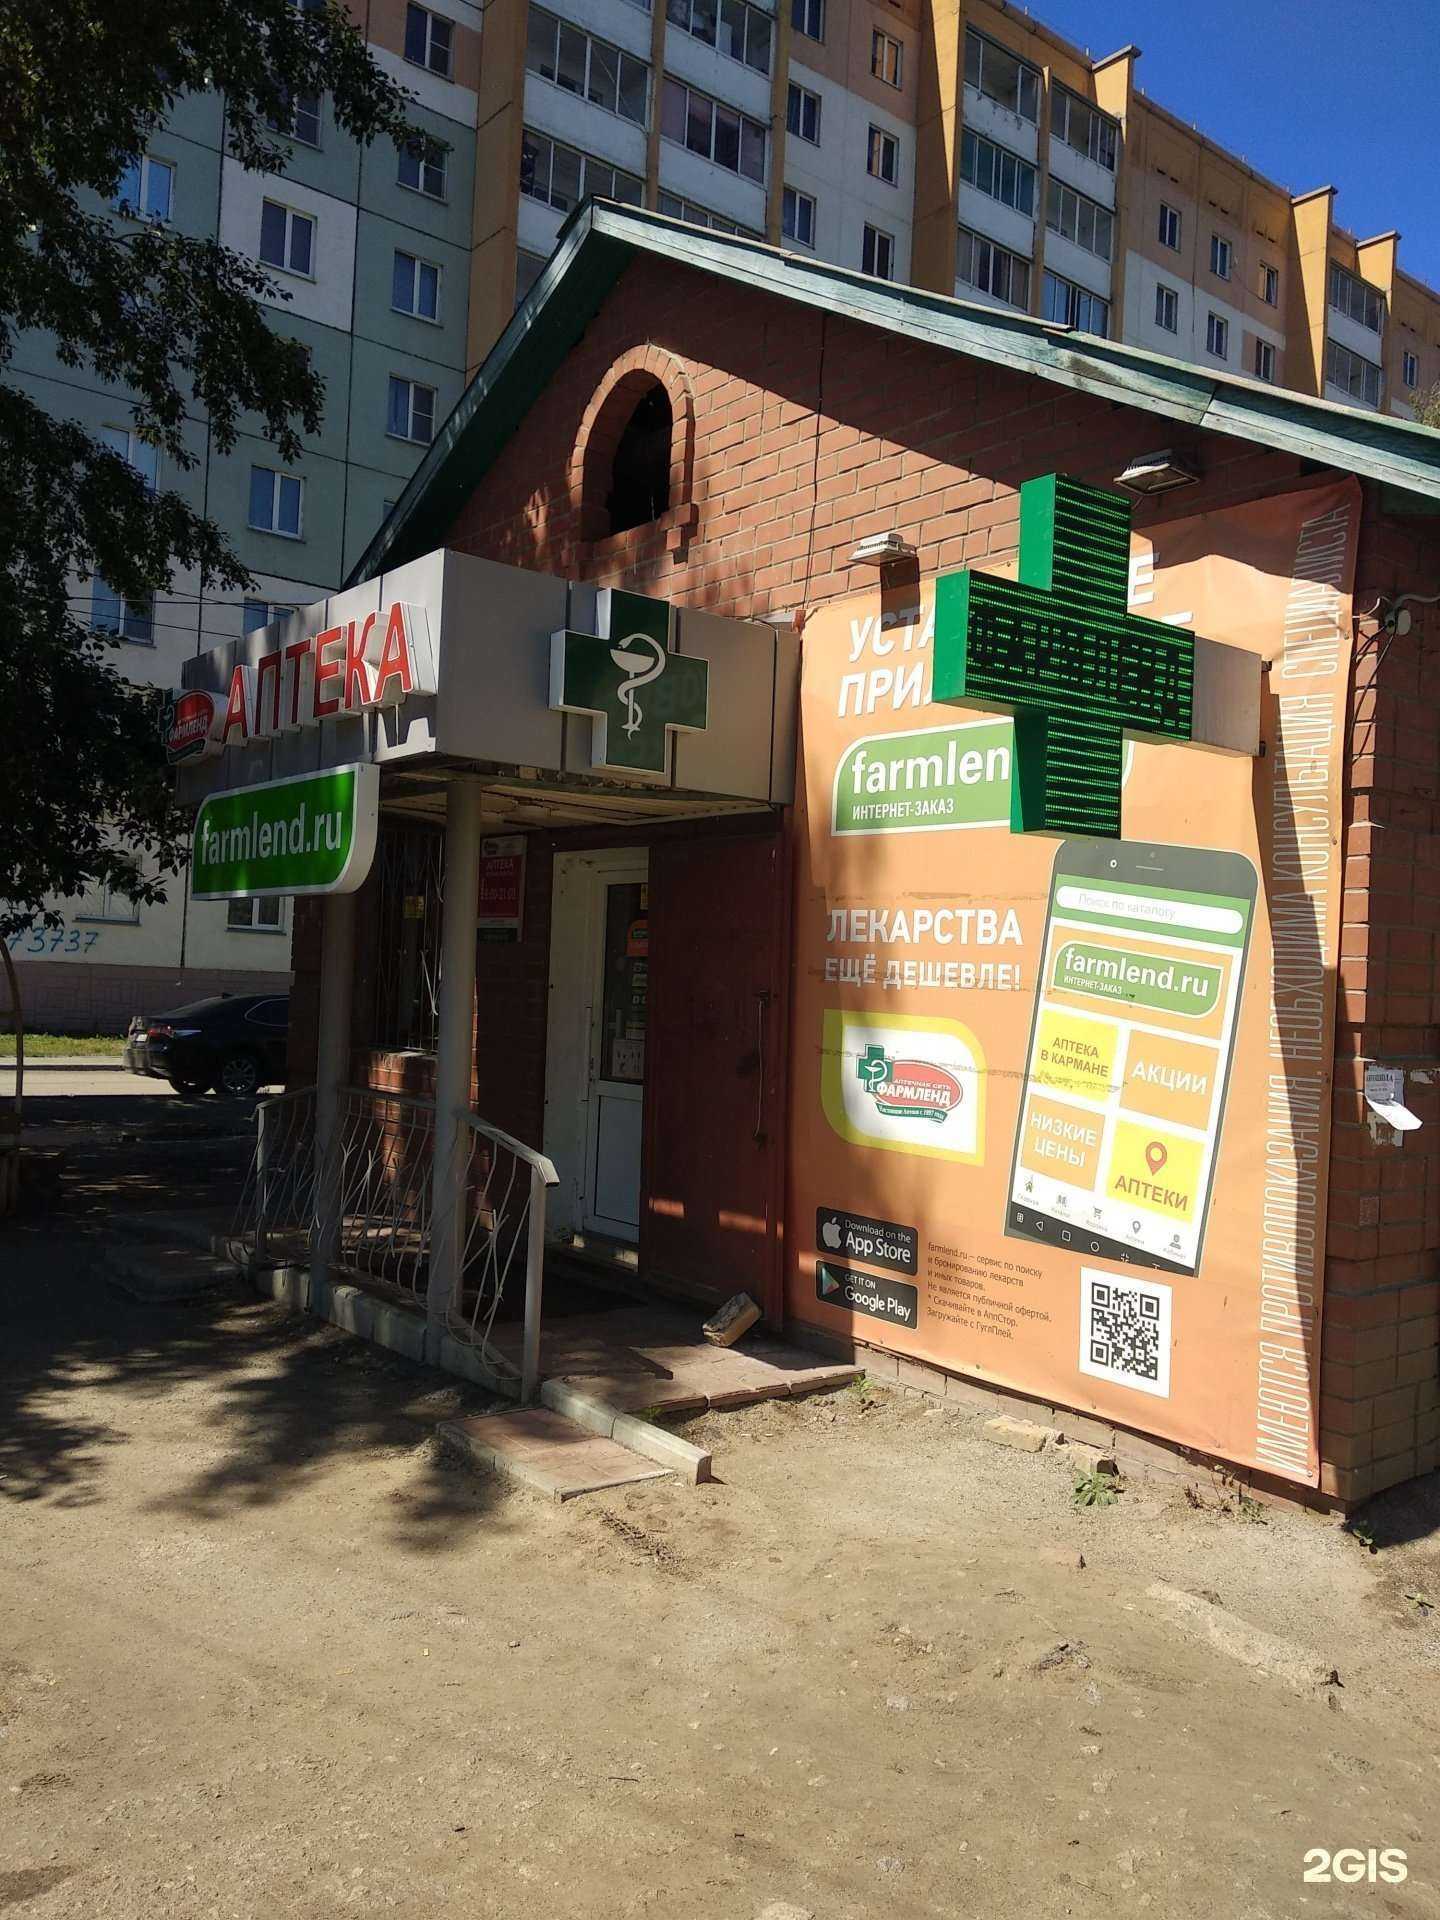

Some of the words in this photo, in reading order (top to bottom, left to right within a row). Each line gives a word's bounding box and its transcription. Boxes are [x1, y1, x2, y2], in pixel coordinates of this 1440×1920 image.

[1281, 504, 1351, 679] СПЕЦИАЛИСТА
[222, 601, 413, 745] АПТЕКА
[838, 662, 933, 718] ПРИ
[851, 740, 1010, 795] farmlen
[1272, 693, 1336, 880] КОНСУЛЬТАЦИЯ
[852, 798, 955, 821] ИНТЕРНЕТ-ЗАКАЗ
[201, 802, 342, 865] farmlend.ru
[826, 908, 1024, 945] ЛЕКАРСТВА
[824, 953, 877, 988] ЕЩЁ
[882, 959, 1021, 991] ДЕШЕВЛЕ!
[1064, 947, 1209, 997] farmlend.ru
[1064, 975, 1122, 995] ИНТЕРНЕТ-ЗАКАЗ
[1269, 889, 1330, 1060] НЕОБХОДИМА
[1040, 1049, 1049, 1061] В
[1051, 1053, 1109, 1078] КАРМАНЕ
[1052, 1037, 1099, 1058] АПТЕКА
[877, 1081, 951, 1106] ФАРМЛЕНД
[1132, 1060, 1207, 1095] АКЦИИ
[1030, 1112, 1097, 1147] НИЗКИЕ
[1034, 1137, 1085, 1167] ЦЕНЫ
[1115, 1175, 1188, 1211] АПТЕКИ
[1260, 1071, 1322, 1340] ПРОТИВОПОКАЗАНИЯ.
[845, 1219, 884, 1236] Download
[886, 1231, 896, 1239] on
[897, 1232, 911, 1243] the
[845, 1231, 874, 1256] App
[876, 1238, 911, 1263] Store
[928, 1242, 968, 1260] farmlend.ru
[976, 1255, 1002, 1269] сервис
[1004, 1261, 1014, 1270] по
[1016, 1264, 1042, 1279] поиску
[934, 1256, 987, 1278] бронированию
[989, 1272, 1024, 1287] лекарств
[844, 1273, 858, 1284] GET
[858, 1277, 864, 1285] IT
[865, 1279, 876, 1289] ON
[928, 1281, 938, 1291] Не
[939, 1287, 971, 1300] является
[972, 1294, 1014, 1312] публичной
[934, 1271, 953, 1281] иных
[954, 1275, 986, 1291] товаров.
[844, 1285, 885, 1312] Google
[887, 1297, 911, 1321] Play
[927, 1307, 969, 1327] Загружайте
[933, 1296, 975, 1316] Скачивайте
[983, 1310, 1018, 1328] АппСтор.
[1256, 1341, 1312, 1477] ИМЕЮТСЯ
